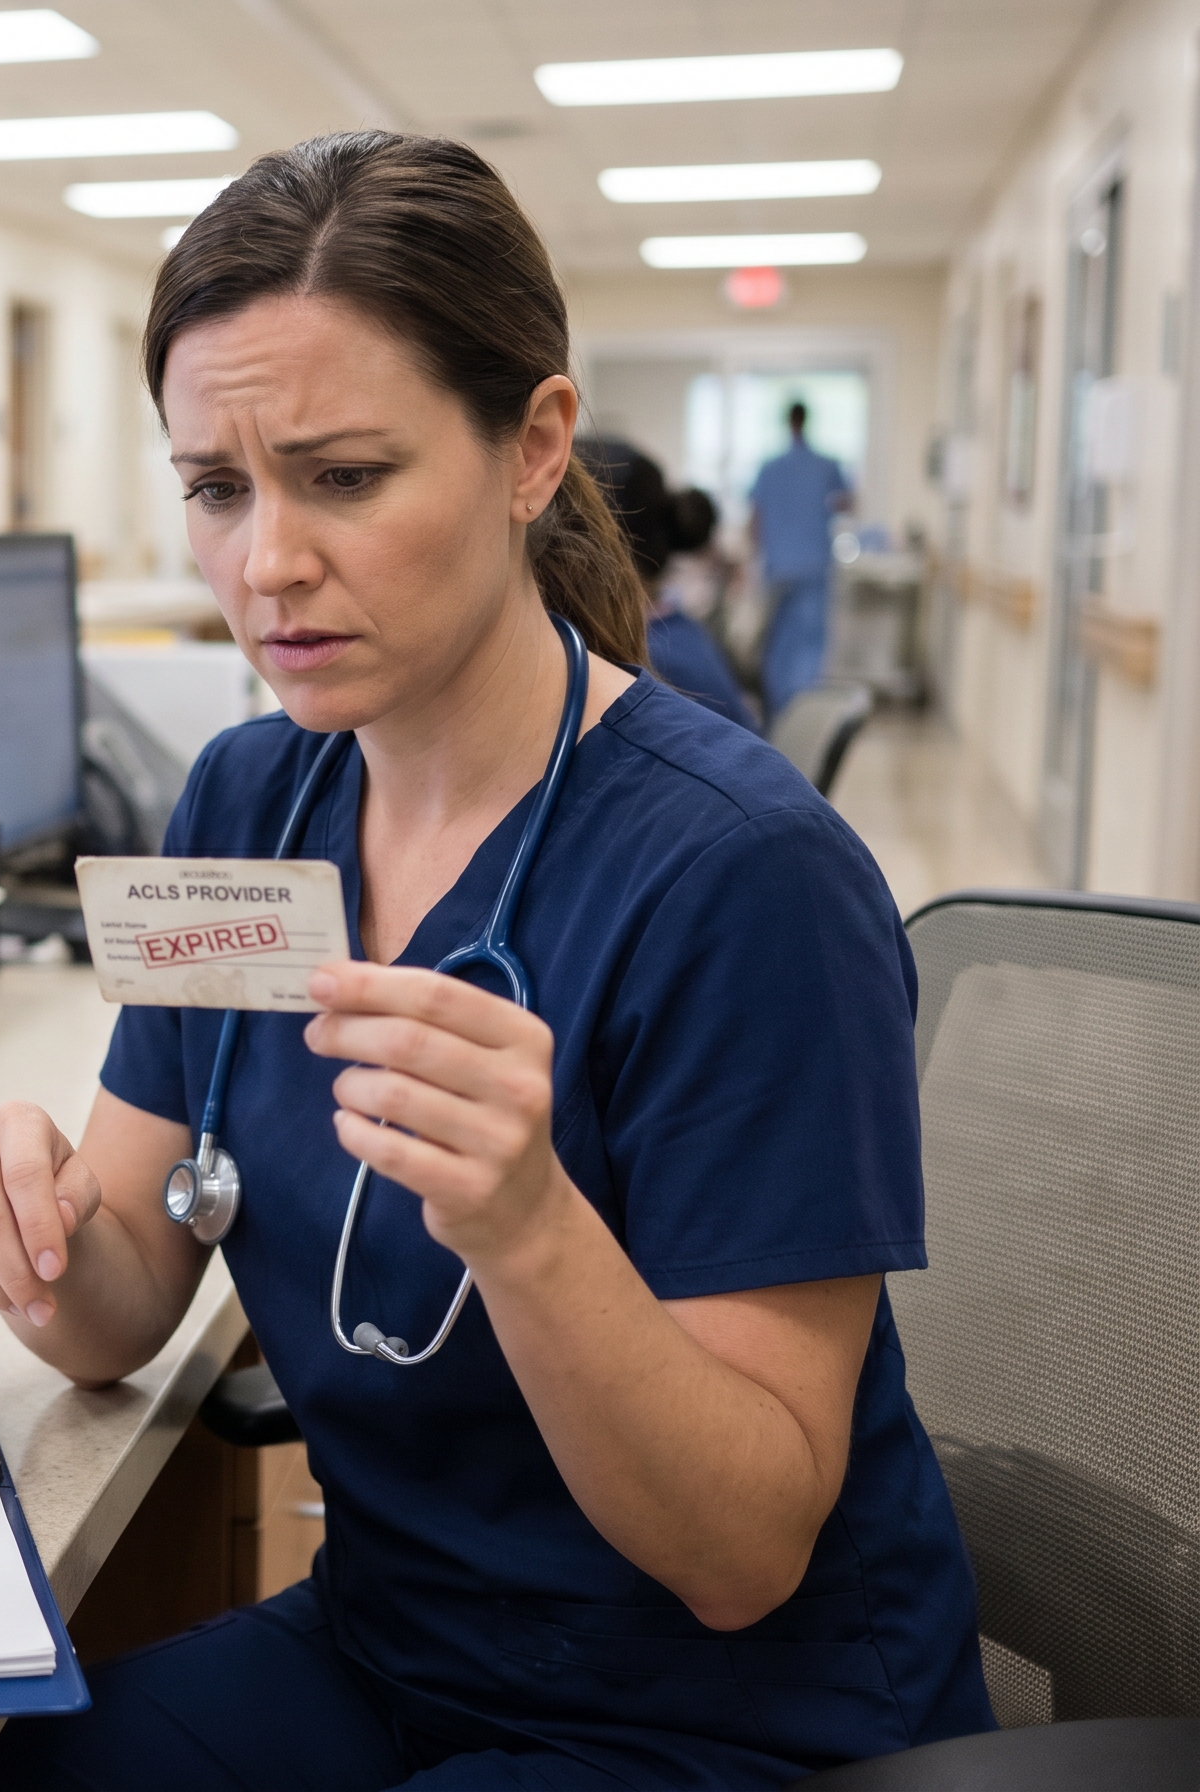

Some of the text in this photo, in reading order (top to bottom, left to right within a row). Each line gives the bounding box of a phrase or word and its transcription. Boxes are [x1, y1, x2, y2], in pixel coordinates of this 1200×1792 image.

[127, 884, 293, 903] ACLS PROVIDER
[144, 922, 278, 962] EXPIRED
